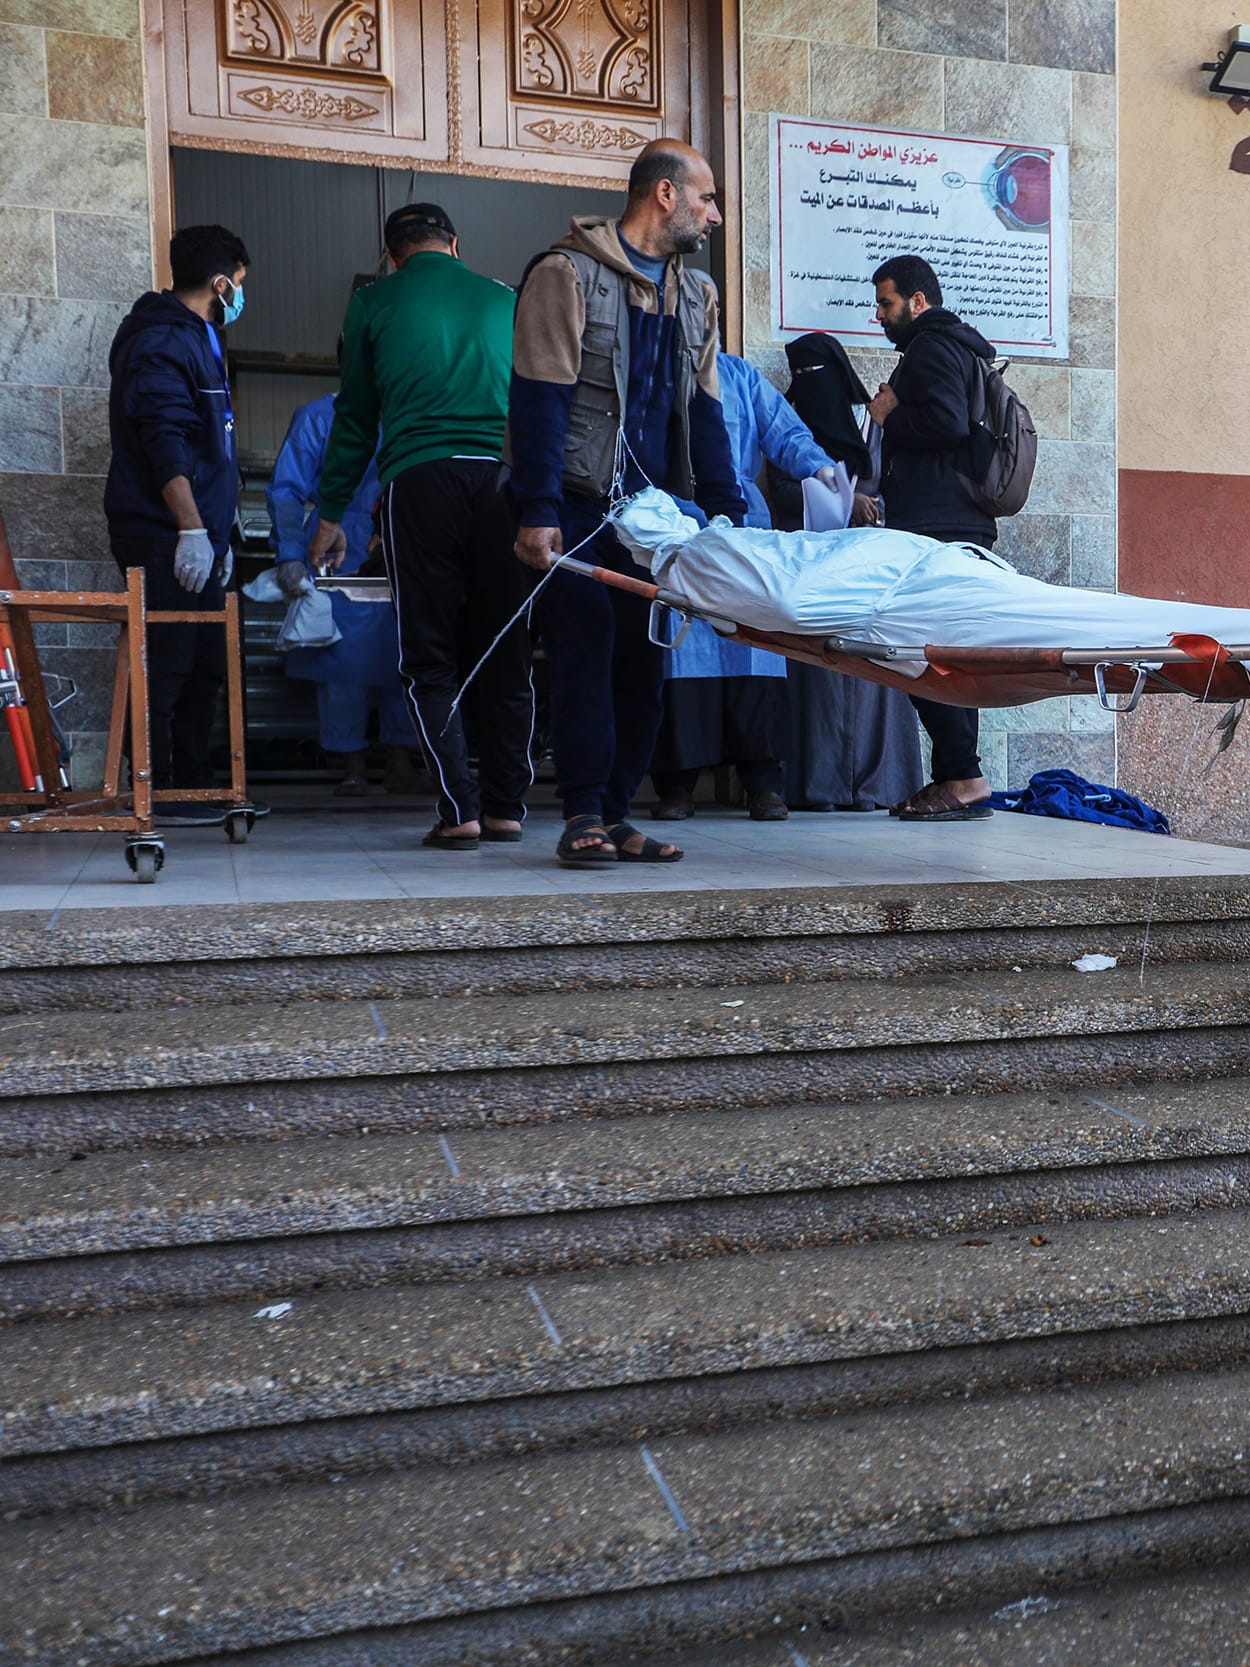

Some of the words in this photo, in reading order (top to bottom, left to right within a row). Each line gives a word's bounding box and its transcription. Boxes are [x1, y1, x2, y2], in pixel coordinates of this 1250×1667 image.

[806, 138, 855, 155] الكريم
[857, 143, 897, 162] المواطن
[899, 146, 939, 165] عزيزي
[799, 190, 825, 208] الميت
[826, 193, 844, 209] عن
[846, 195, 895, 211] الصدقات
